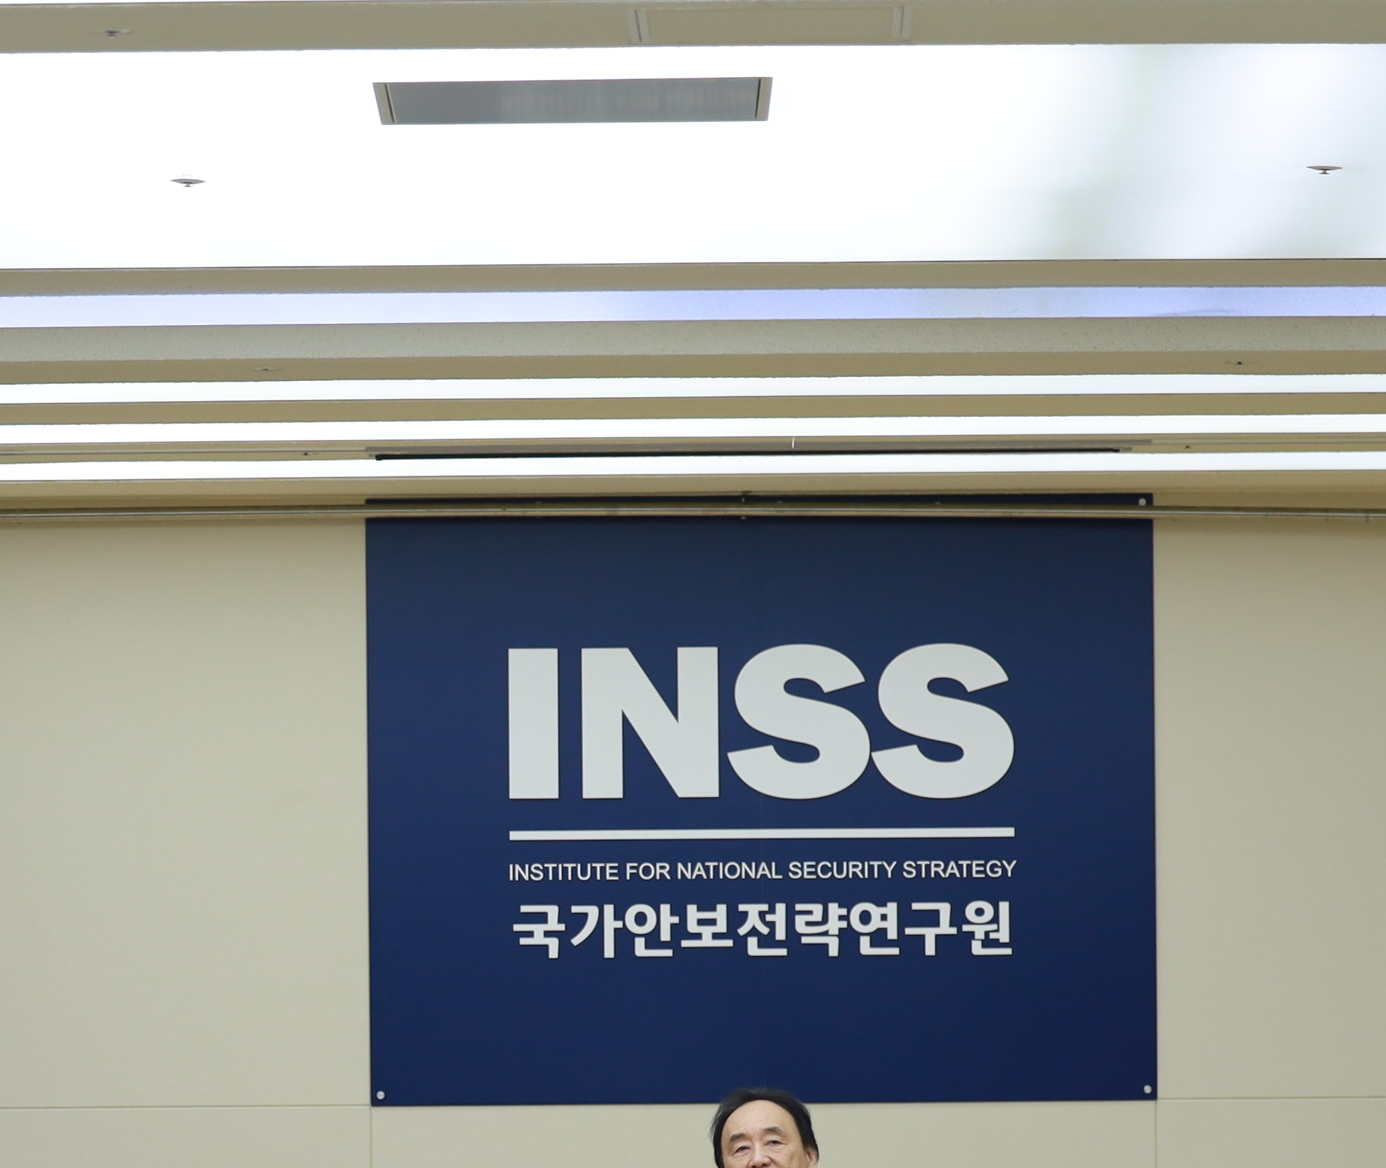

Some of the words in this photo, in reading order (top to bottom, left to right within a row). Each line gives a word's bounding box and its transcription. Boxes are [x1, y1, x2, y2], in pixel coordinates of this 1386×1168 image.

[508, 643, 1014, 799] INSS
[509, 863, 619, 881] INSTITUTE
[626, 863, 672, 880] FOR
[677, 862, 784, 880] NATIONAL
[788, 861, 897, 879] SECURITY
[902, 860, 1017, 879] STRATEGY
[512, 900, 1014, 959] 국가안보전략연구원
